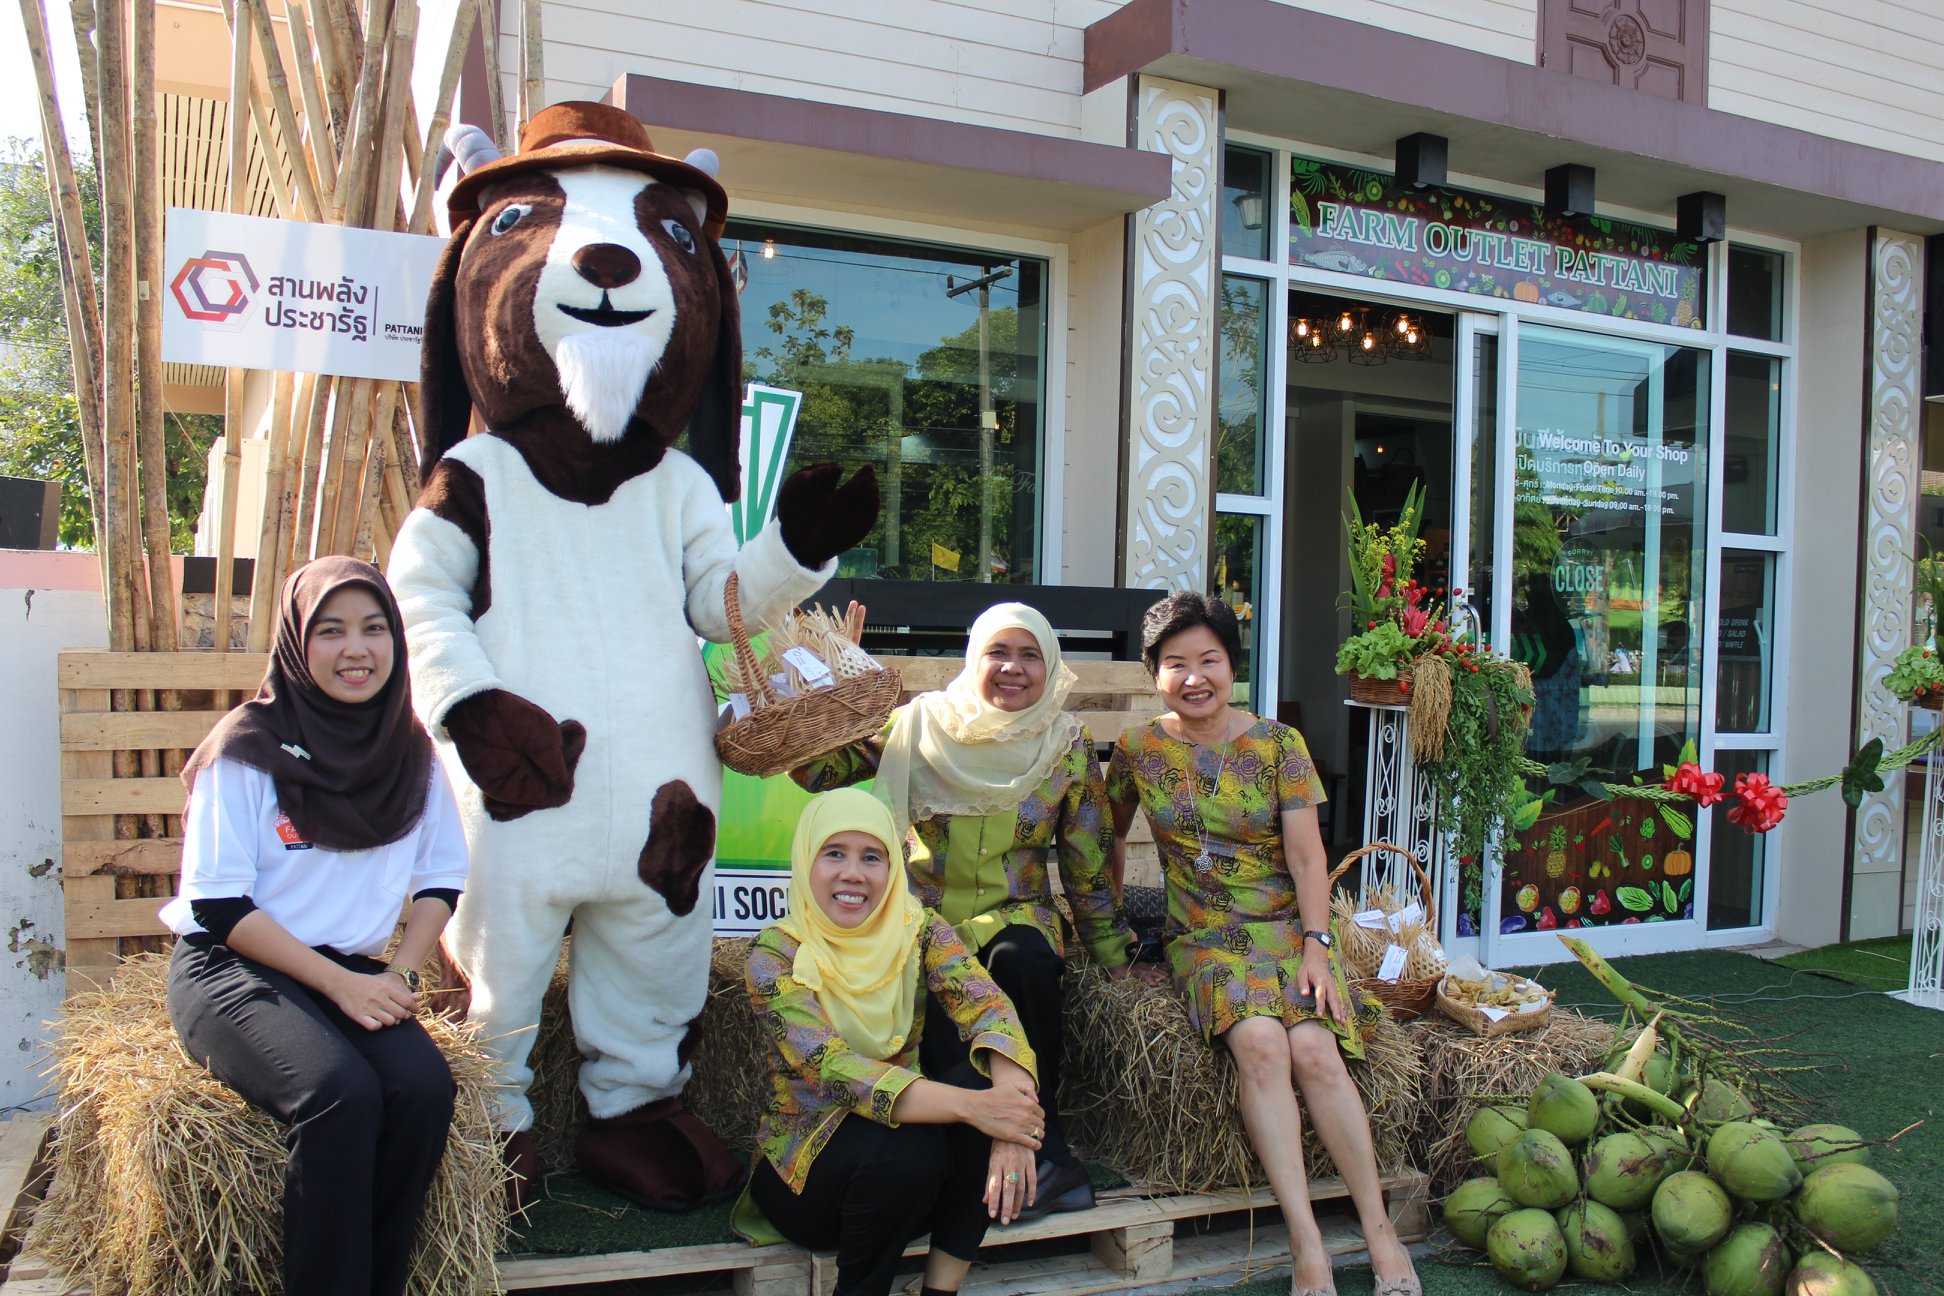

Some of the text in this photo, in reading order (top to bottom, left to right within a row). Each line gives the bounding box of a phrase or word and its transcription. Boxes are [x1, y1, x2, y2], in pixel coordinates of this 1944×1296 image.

[1317, 201, 1679, 298] FARM OUTLET PATTANI
[268, 276, 367, 304] สานพลัง
[265, 300, 367, 342] ประชารัฐ
[384, 323, 423, 336] PATTANI
[1538, 432, 1601, 453] Welcome
[1604, 439, 1620, 455] To
[1623, 441, 1653, 459] Your
[1656, 445, 1689, 465] Shop
[1583, 460, 1646, 482] Open Daily
[1555, 565, 1604, 592] CLOSE
